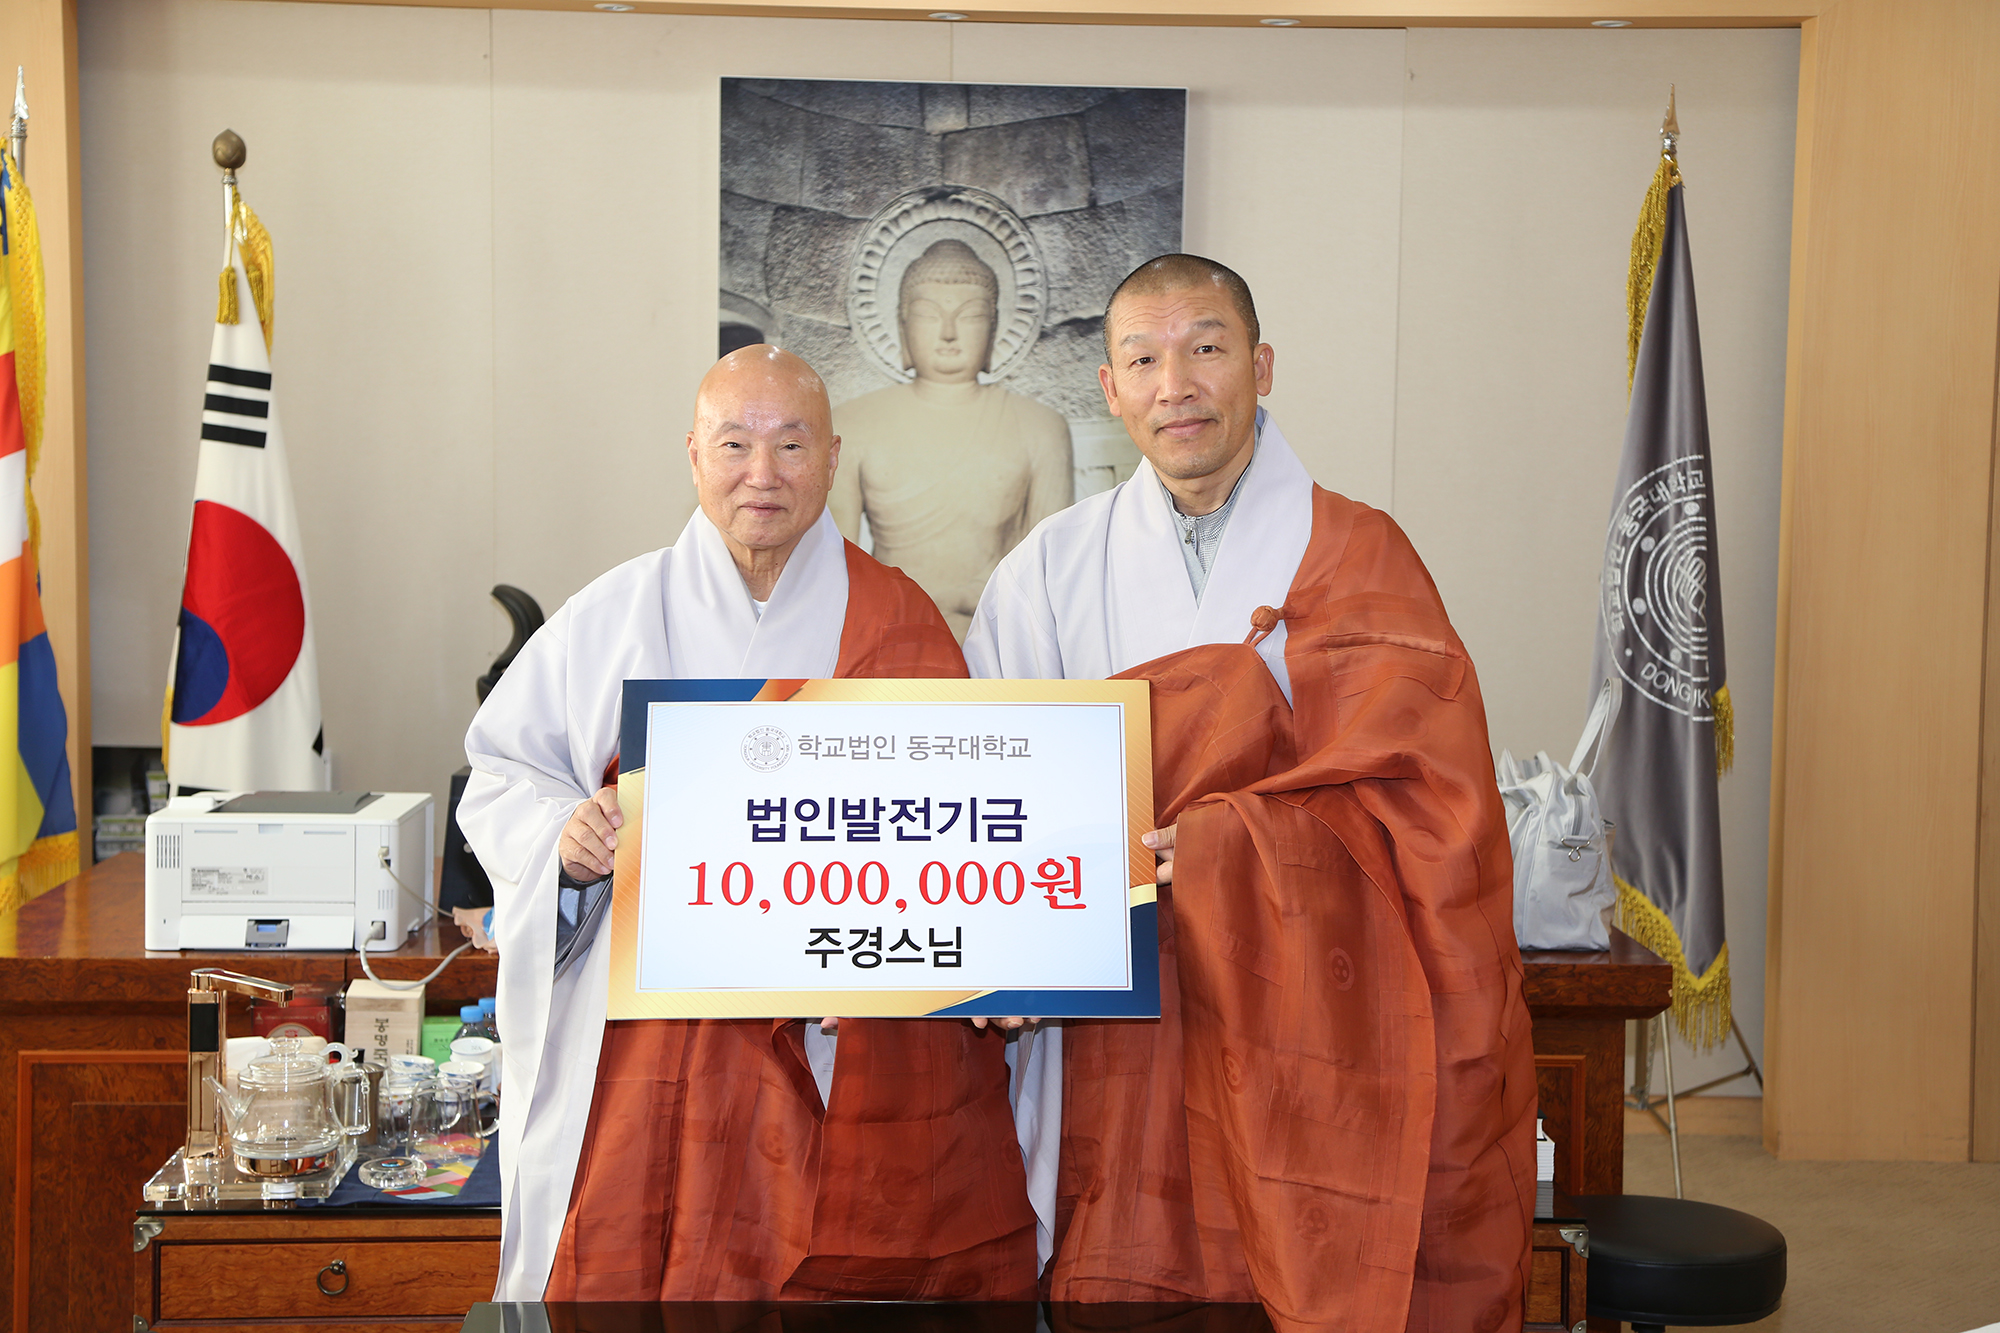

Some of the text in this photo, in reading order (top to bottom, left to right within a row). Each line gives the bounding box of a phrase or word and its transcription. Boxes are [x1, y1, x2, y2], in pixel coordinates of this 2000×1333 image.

[1618, 469, 1706, 538] 동국대학교
[798, 735, 1032, 761] 학교법인 동국대학교
[746, 796, 1028, 843] 법인발전기금
[687, 855, 1088, 915] 10,000,000원
[804, 925, 962, 970] 주경스님
